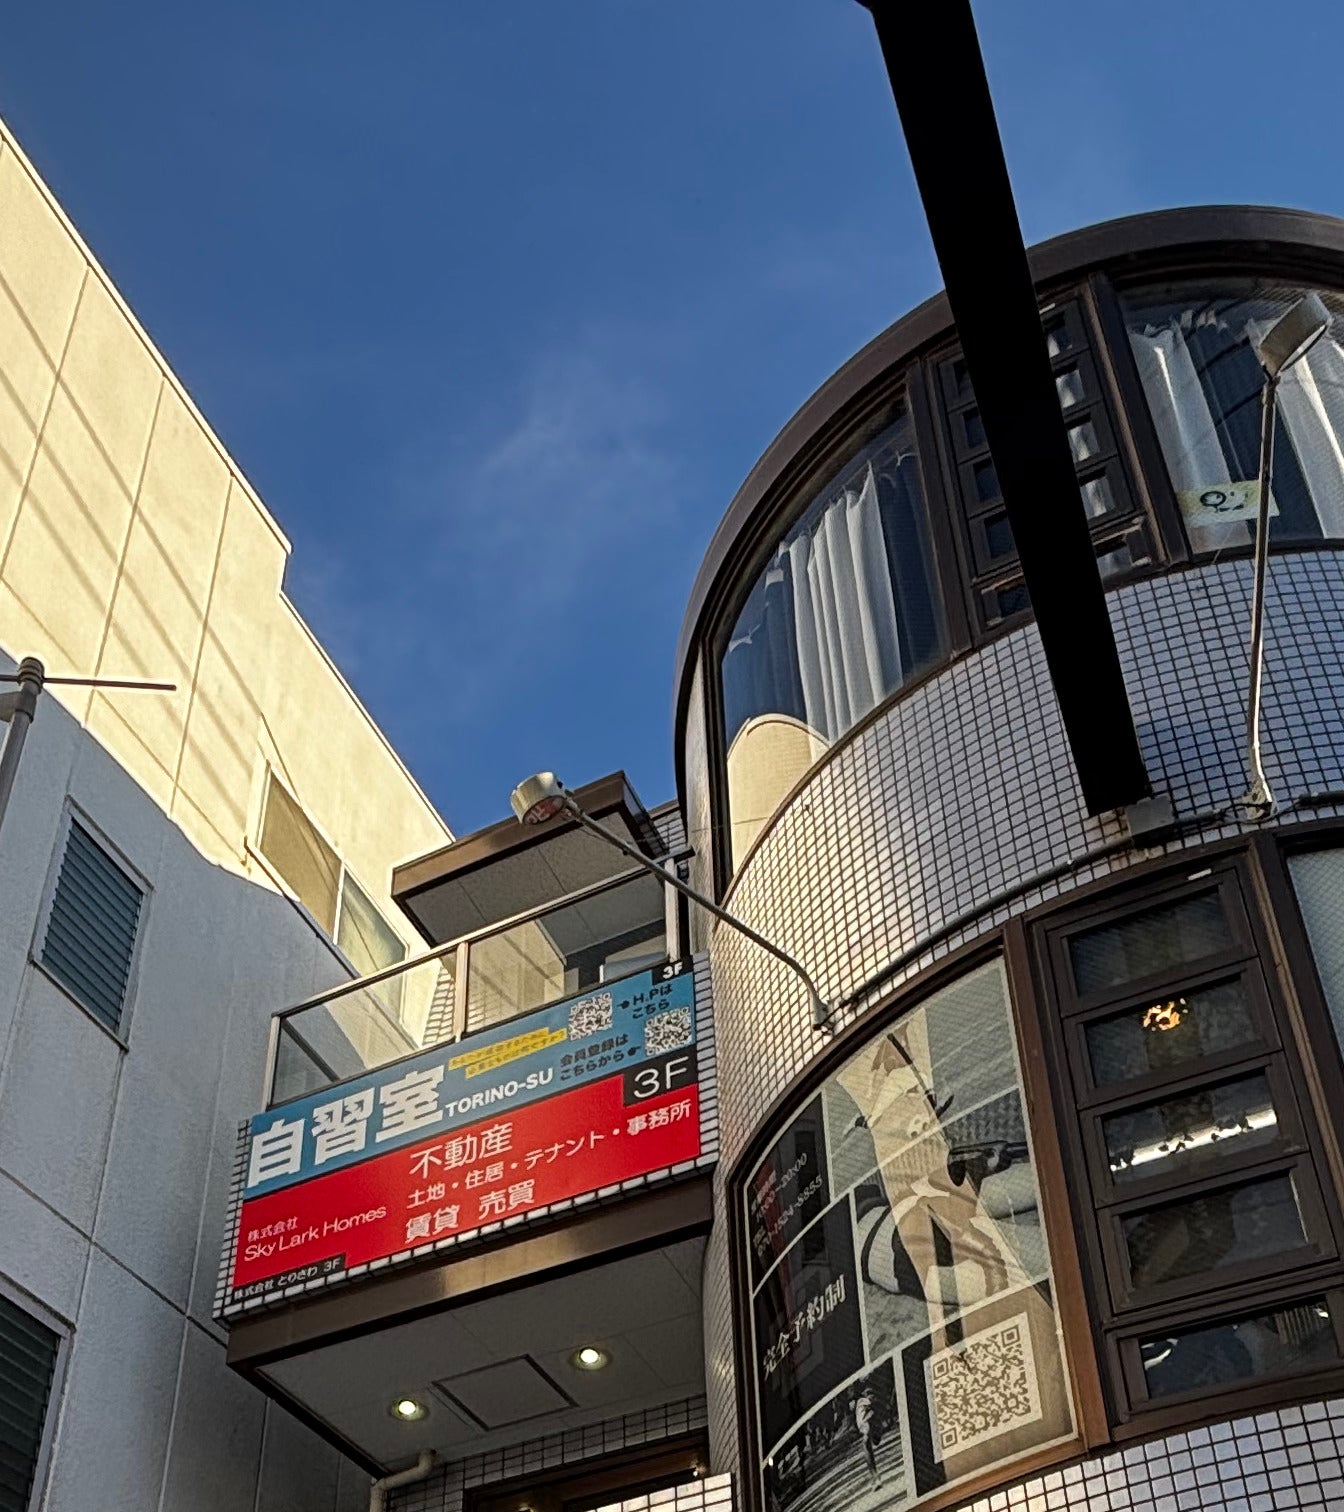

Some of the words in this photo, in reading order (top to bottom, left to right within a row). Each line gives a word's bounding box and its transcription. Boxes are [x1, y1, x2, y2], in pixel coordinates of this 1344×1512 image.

[662, 964, 683, 980] 3F
[445, 1067, 554, 1118] TORINO-SU
[633, 1056, 689, 1099] 3F
[247, 1065, 450, 1188] 自習室
[409, 1122, 514, 1179] 不動産
[244, 1243, 277, 1263] Sky
[279, 1226, 319, 1252] Lark
[322, 1206, 387, 1238] Homes
[247, 1216, 298, 1243] 株式会社
[404, 1204, 461, 1245] 賃貸
[478, 1178, 536, 1221] 売買
[323, 1258, 342, 1273] 3F
[763, 1273, 847, 1381] 完全予約制
